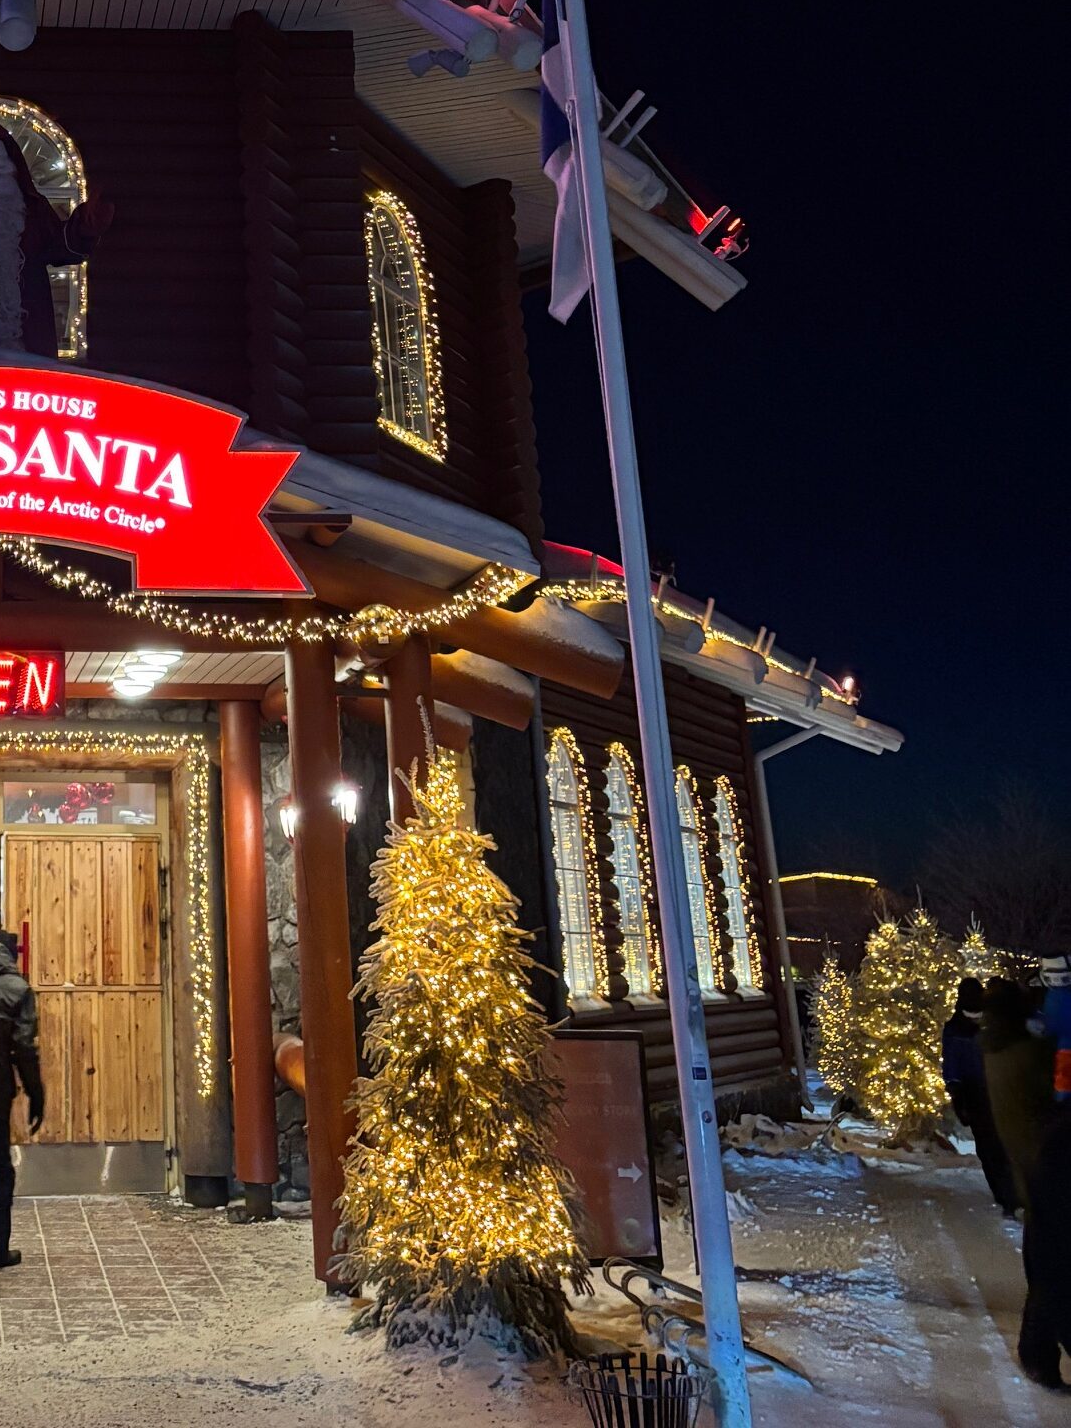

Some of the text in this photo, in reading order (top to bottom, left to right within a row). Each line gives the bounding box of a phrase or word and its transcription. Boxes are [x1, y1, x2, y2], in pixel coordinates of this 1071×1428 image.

[12, 390, 97, 420] HOUSE
[19, 493, 46, 512] the
[48, 496, 100, 520] Arctic
